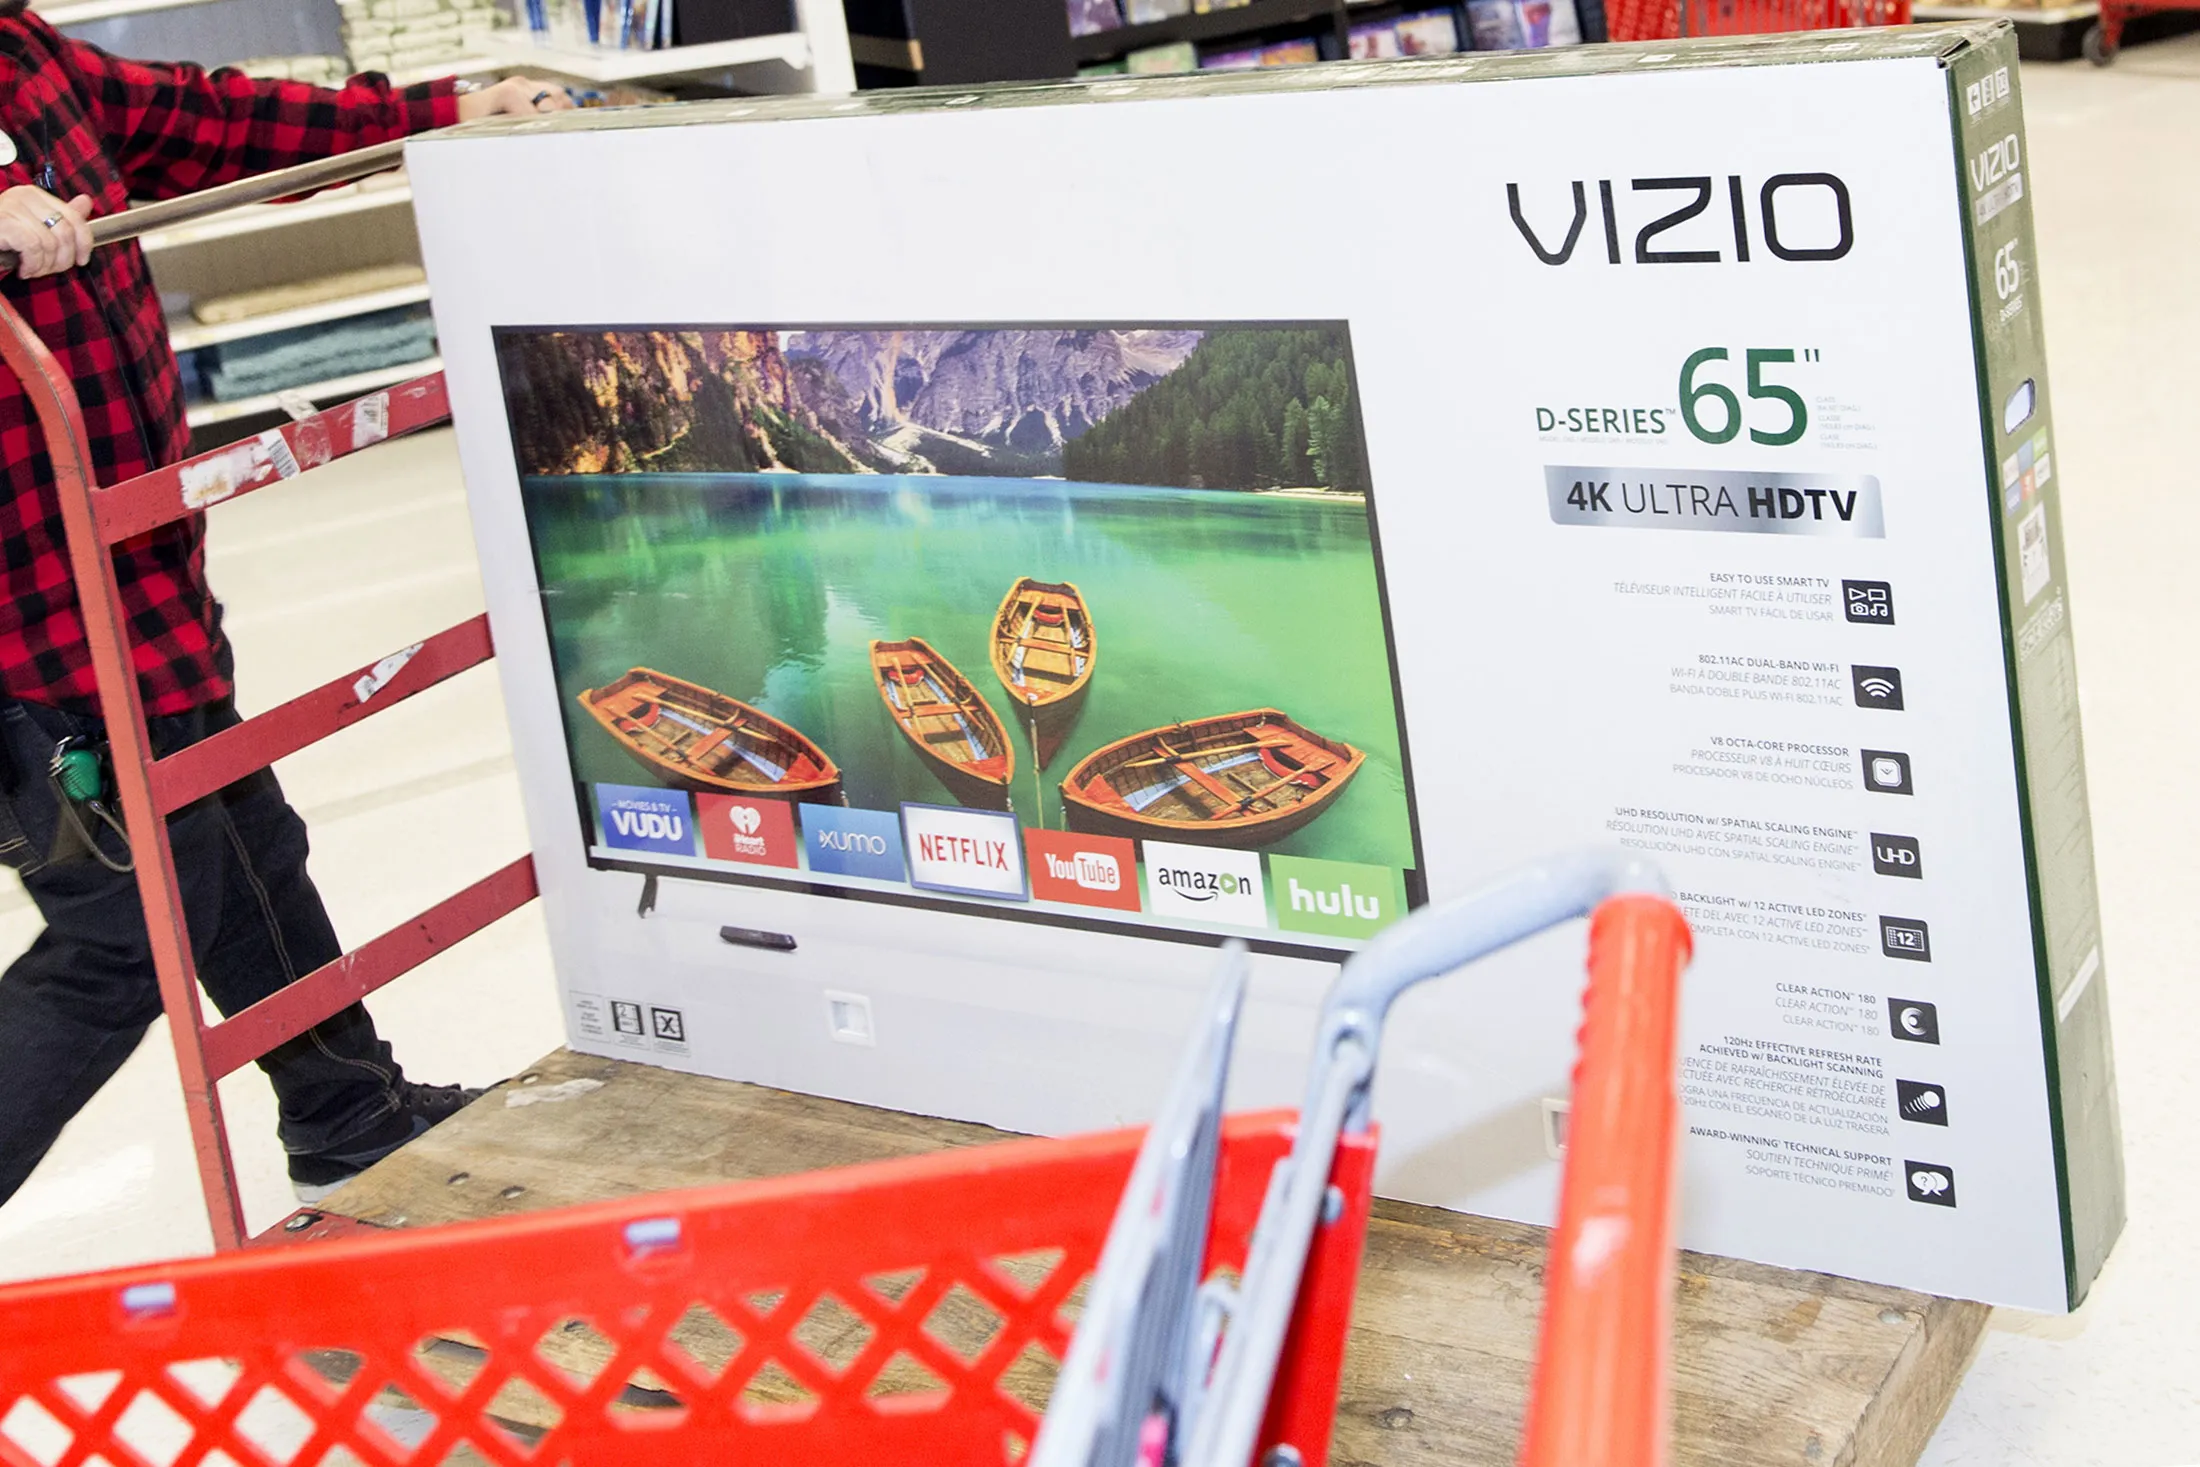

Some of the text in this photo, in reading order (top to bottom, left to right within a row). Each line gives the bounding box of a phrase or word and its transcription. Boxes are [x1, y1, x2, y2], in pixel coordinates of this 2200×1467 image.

[1970, 133, 2020, 193] VIZIO
[1506, 171, 1855, 266] VIZIO
[1566, 481, 1858, 521] 4K ULTRA HDTV
[1710, 573, 1830, 588] EASY TO USE SMART TV
[1673, 585, 1737, 600] INTELLIGENT
[1740, 589, 1774, 602] FACILE
[1786, 592, 1832, 606] UTILISER
[1709, 604, 1742, 616] SMART
[1745, 606, 1758, 616] TV
[1789, 609, 1804, 619] DE
[1806, 610, 1834, 621] USAR
[1698, 654, 1839, 673] 802.11AC DUAL-BAND WI-FI
[1671, 667, 1696, 679] WI-FI
[1708, 669, 1750, 683] DOUBLE
[1753, 673, 1789, 685] BANDE
[1791, 676, 1841, 689] 802.11AC
[1669, 683, 1705, 695] BANDA
[1706, 686, 1740, 698] DOBLE
[1742, 689, 1767, 700] PLUS
[1796, 693, 1843, 706] 802.11AC
[1691, 749, 1757, 764] PROCESSEUR
[1759, 756, 1773, 766] V8
[1784, 759, 1811, 769] HUIT
[1710, 737, 1849, 757] V8 OCTA-CORE PROCESSOR
[1672, 764, 1740, 779] PROCESADOR
[1741, 771, 1753, 780] V8
[1755, 772, 1769, 782] DE
[1771, 773, 1803, 785] OCHO
[610, 809, 684, 842] VUDU
[1615, 807, 1638, 818] UHD
[1640, 809, 1704, 824] RESOLUTION
[1721, 817, 1762, 830] SPATIAL
[1764, 822, 1810, 835] SCALING
[734, 843, 767, 856] RADIO
[1670, 827, 1695, 839] UHD
[1695, 830, 1721, 842] AVEC
[1723, 832, 1763, 846] SPATIAL
[1765, 836, 1810, 851] SCALING
[918, 832, 1012, 872] NETFLIX
[1682, 844, 1706, 856] UHD
[1707, 846, 1730, 858] CON
[1732, 849, 1770, 863] SPATIAL
[1772, 853, 1816, 868] SCALING
[1876, 846, 1916, 865] UHD
[1044, 851, 1120, 890] YouTube
[1158, 865, 1252, 899] amazon
[1288, 877, 1381, 920] hulu
[1680, 892, 1736, 906] BACKLIGHT
[1738, 900, 1751, 908] w/
[1754, 901, 1765, 910] 12
[1768, 902, 1804, 915] ACTIVE
[1806, 907, 1826, 917] LED
[1703, 909, 1721, 920] DEL
[1724, 912, 1749, 924] AVEC
[1753, 915, 1765, 926] 12
[1767, 917, 1802, 930] ACTIVE
[1804, 921, 1825, 933] LED
[1690, 924, 1735, 937] OMPLETA
[1737, 929, 1759, 940] CON
[1762, 932, 1774, 943] 12
[1776, 934, 1810, 947] ACTIVE
[1811, 938, 1831, 949] LED
[1896, 931, 1915, 946] 12
[1776, 982, 1808, 995] CLEAR
[1858, 994, 1876, 1004] 180
[1775, 996, 1807, 1010] CLEAR
[1858, 1008, 1878, 1020] 180
[1782, 1014, 1814, 1026] CLEAR
[1861, 1025, 1880, 1036] 180
[1699, 1044, 1883, 1079] ACHIEVED w/ BACKLIGHT SCANNING
[1724, 1036, 1882, 1067] 120Hz EFFECTIVE REFRESH RATE
[1714, 1061, 1728, 1072] DE
[1871, 1084, 1886, 1096] DE
[1716, 1074, 1741, 1087] AVEC
[1743, 1077, 1804, 1096] RECHERCHE
[1707, 1088, 1729, 1100] UNA
[1730, 1091, 1790, 1109] FRECUENCIA
[1792, 1101, 1806, 1112] DE
[1708, 1099, 1731, 1112] CON
[1733, 1103, 1744, 1114] EL
[1746, 1105, 1792, 1121] ESCANEO
[1793, 1112, 1807, 1123] DE
[1809, 1115, 1822, 1126] LA
[1824, 1118, 1844, 1129] LUZ
[1845, 1120, 1890, 1136] TRASERA
[1745, 1149, 1791, 1165] SOUTIEN
[1793, 1156, 1854, 1176] TECHNIQUE
[1783, 1141, 1841, 1159] TECHNICAL
[1843, 1150, 1892, 1166] SUPPORT
[1745, 1164, 1792, 1181] SOPORTE
